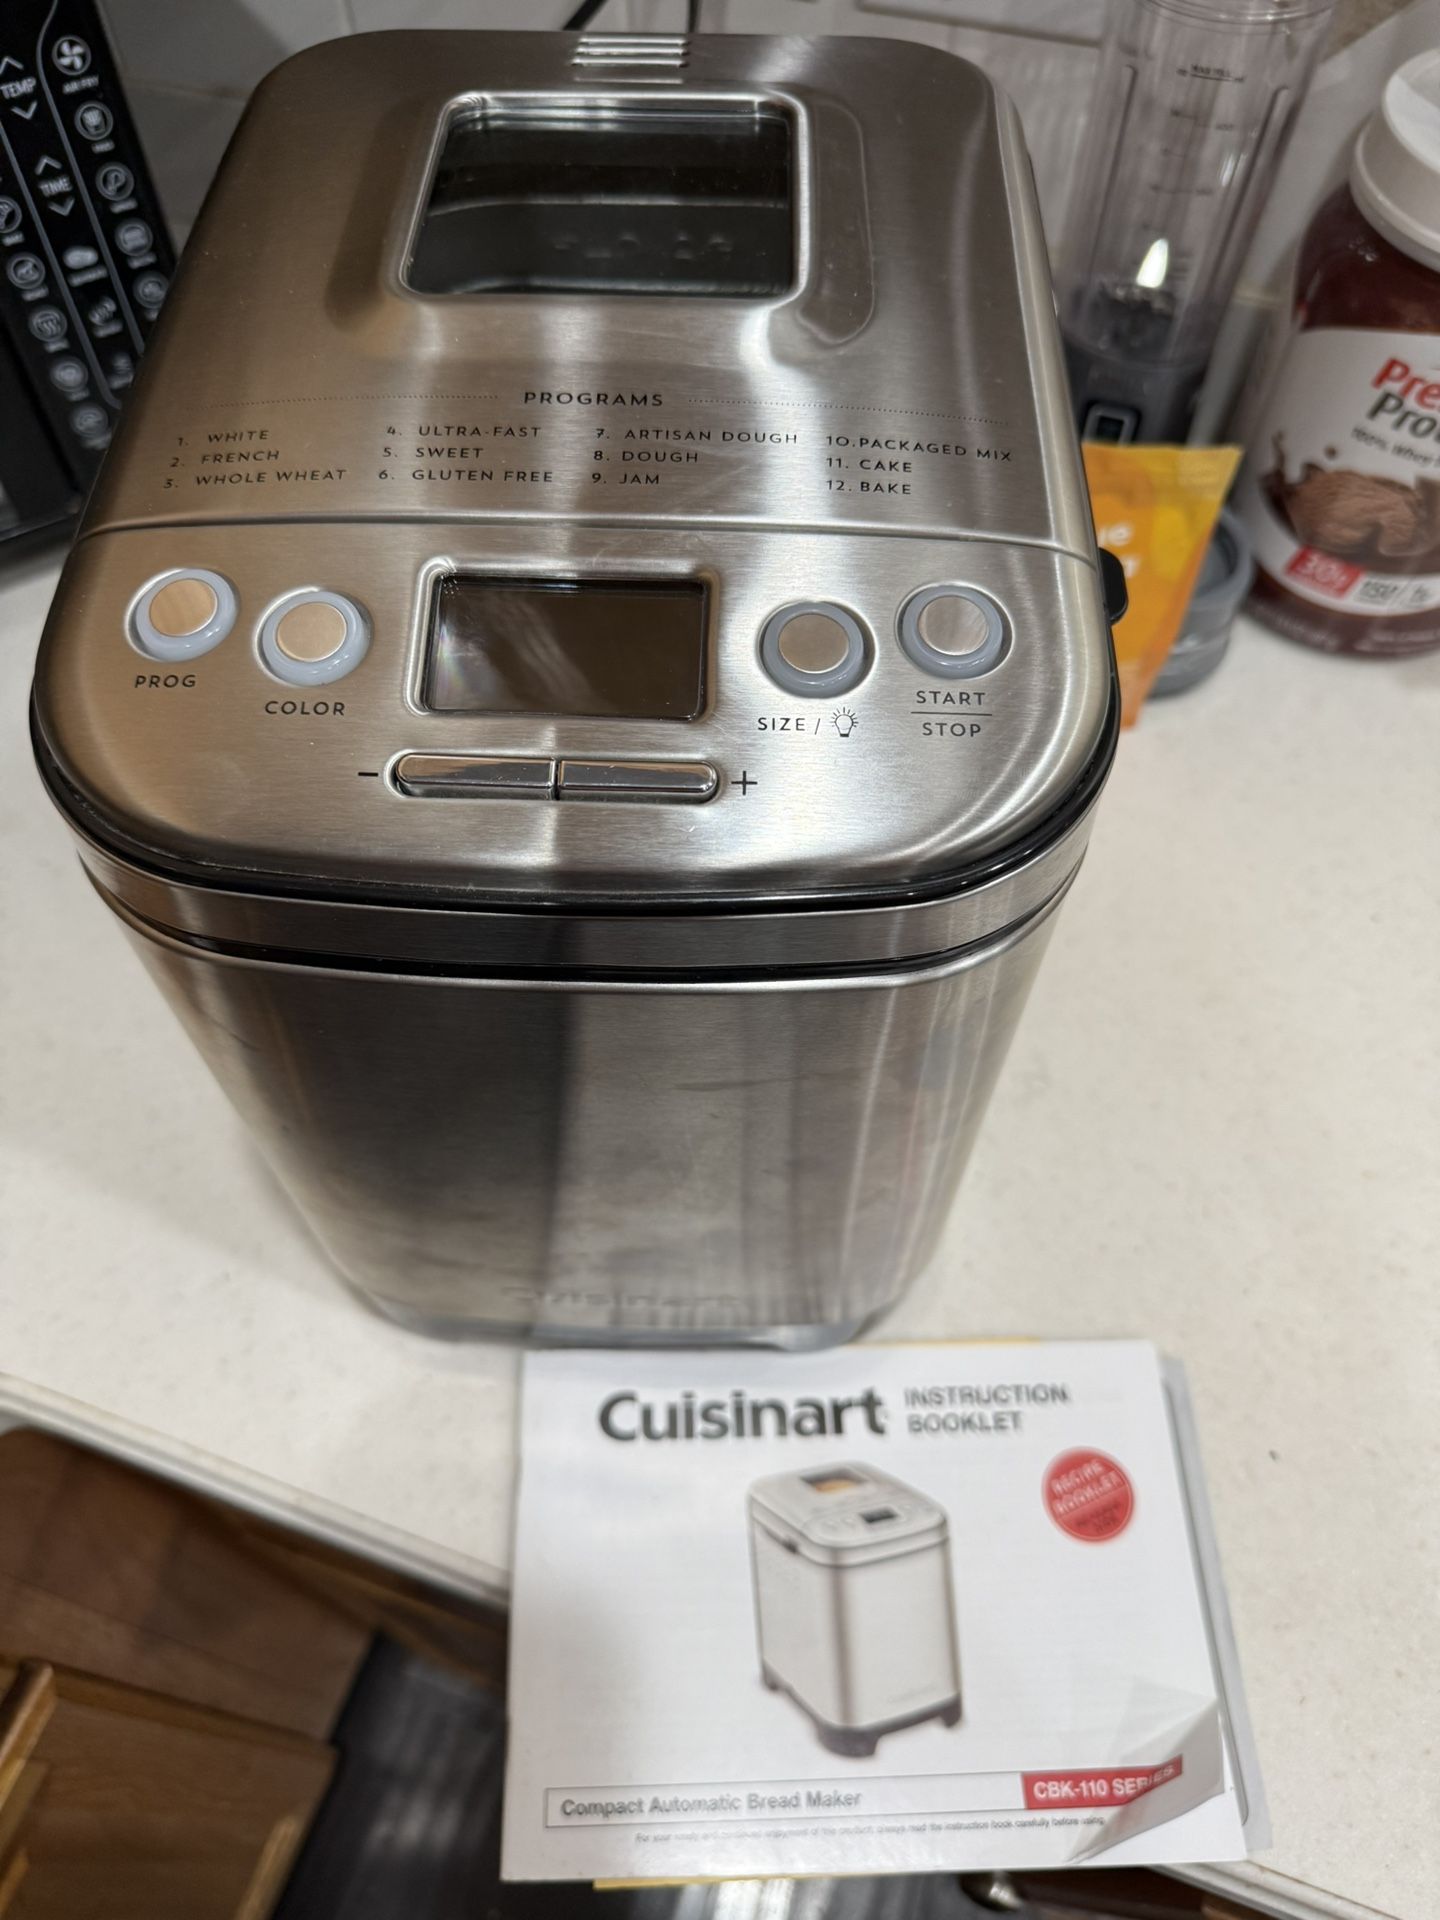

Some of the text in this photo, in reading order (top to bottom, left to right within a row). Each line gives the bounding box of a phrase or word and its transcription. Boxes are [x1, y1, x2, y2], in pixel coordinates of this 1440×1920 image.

[0, 77, 36, 99] TEMP
[39, 175, 72, 197] TIME
[524, 391, 663, 406] PROGRAMS
[1366, 391, 1440, 444] Pro
[178, 430, 269, 446] 1. WHITE
[387, 425, 542, 438] 4. ULTRA-FAST
[596, 429, 798, 445] 7. ARTISAN DOUGH
[171, 450, 280, 468] 2. FRENCH
[383, 447, 484, 459] 5. SWEET
[594, 450, 698, 463] 8. DOUGH
[977, 448, 1012, 462] MIX
[826, 458, 913, 473] 11. CAKE
[164, 469, 347, 489] 3. WHOLE WHEAT
[379, 469, 554, 483] 6. GLUTEN FREE
[592, 473, 660, 485] 9. JAM
[825, 480, 912, 495] 12. BAKE
[134, 674, 197, 689] PROG
[916, 690, 986, 705] START
[265, 700, 346, 716] COLOR
[757, 717, 806, 732] SIZE
[922, 722, 983, 737] STOP
[599, 1384, 1070, 1441] Cuisinart INSTRUCTION
[908, 1411, 1023, 1434] BOOKLET
[1033, 1778, 1109, 1799] CBK-110
[561, 1790, 862, 1819] Compact Automatic Bread Maker
